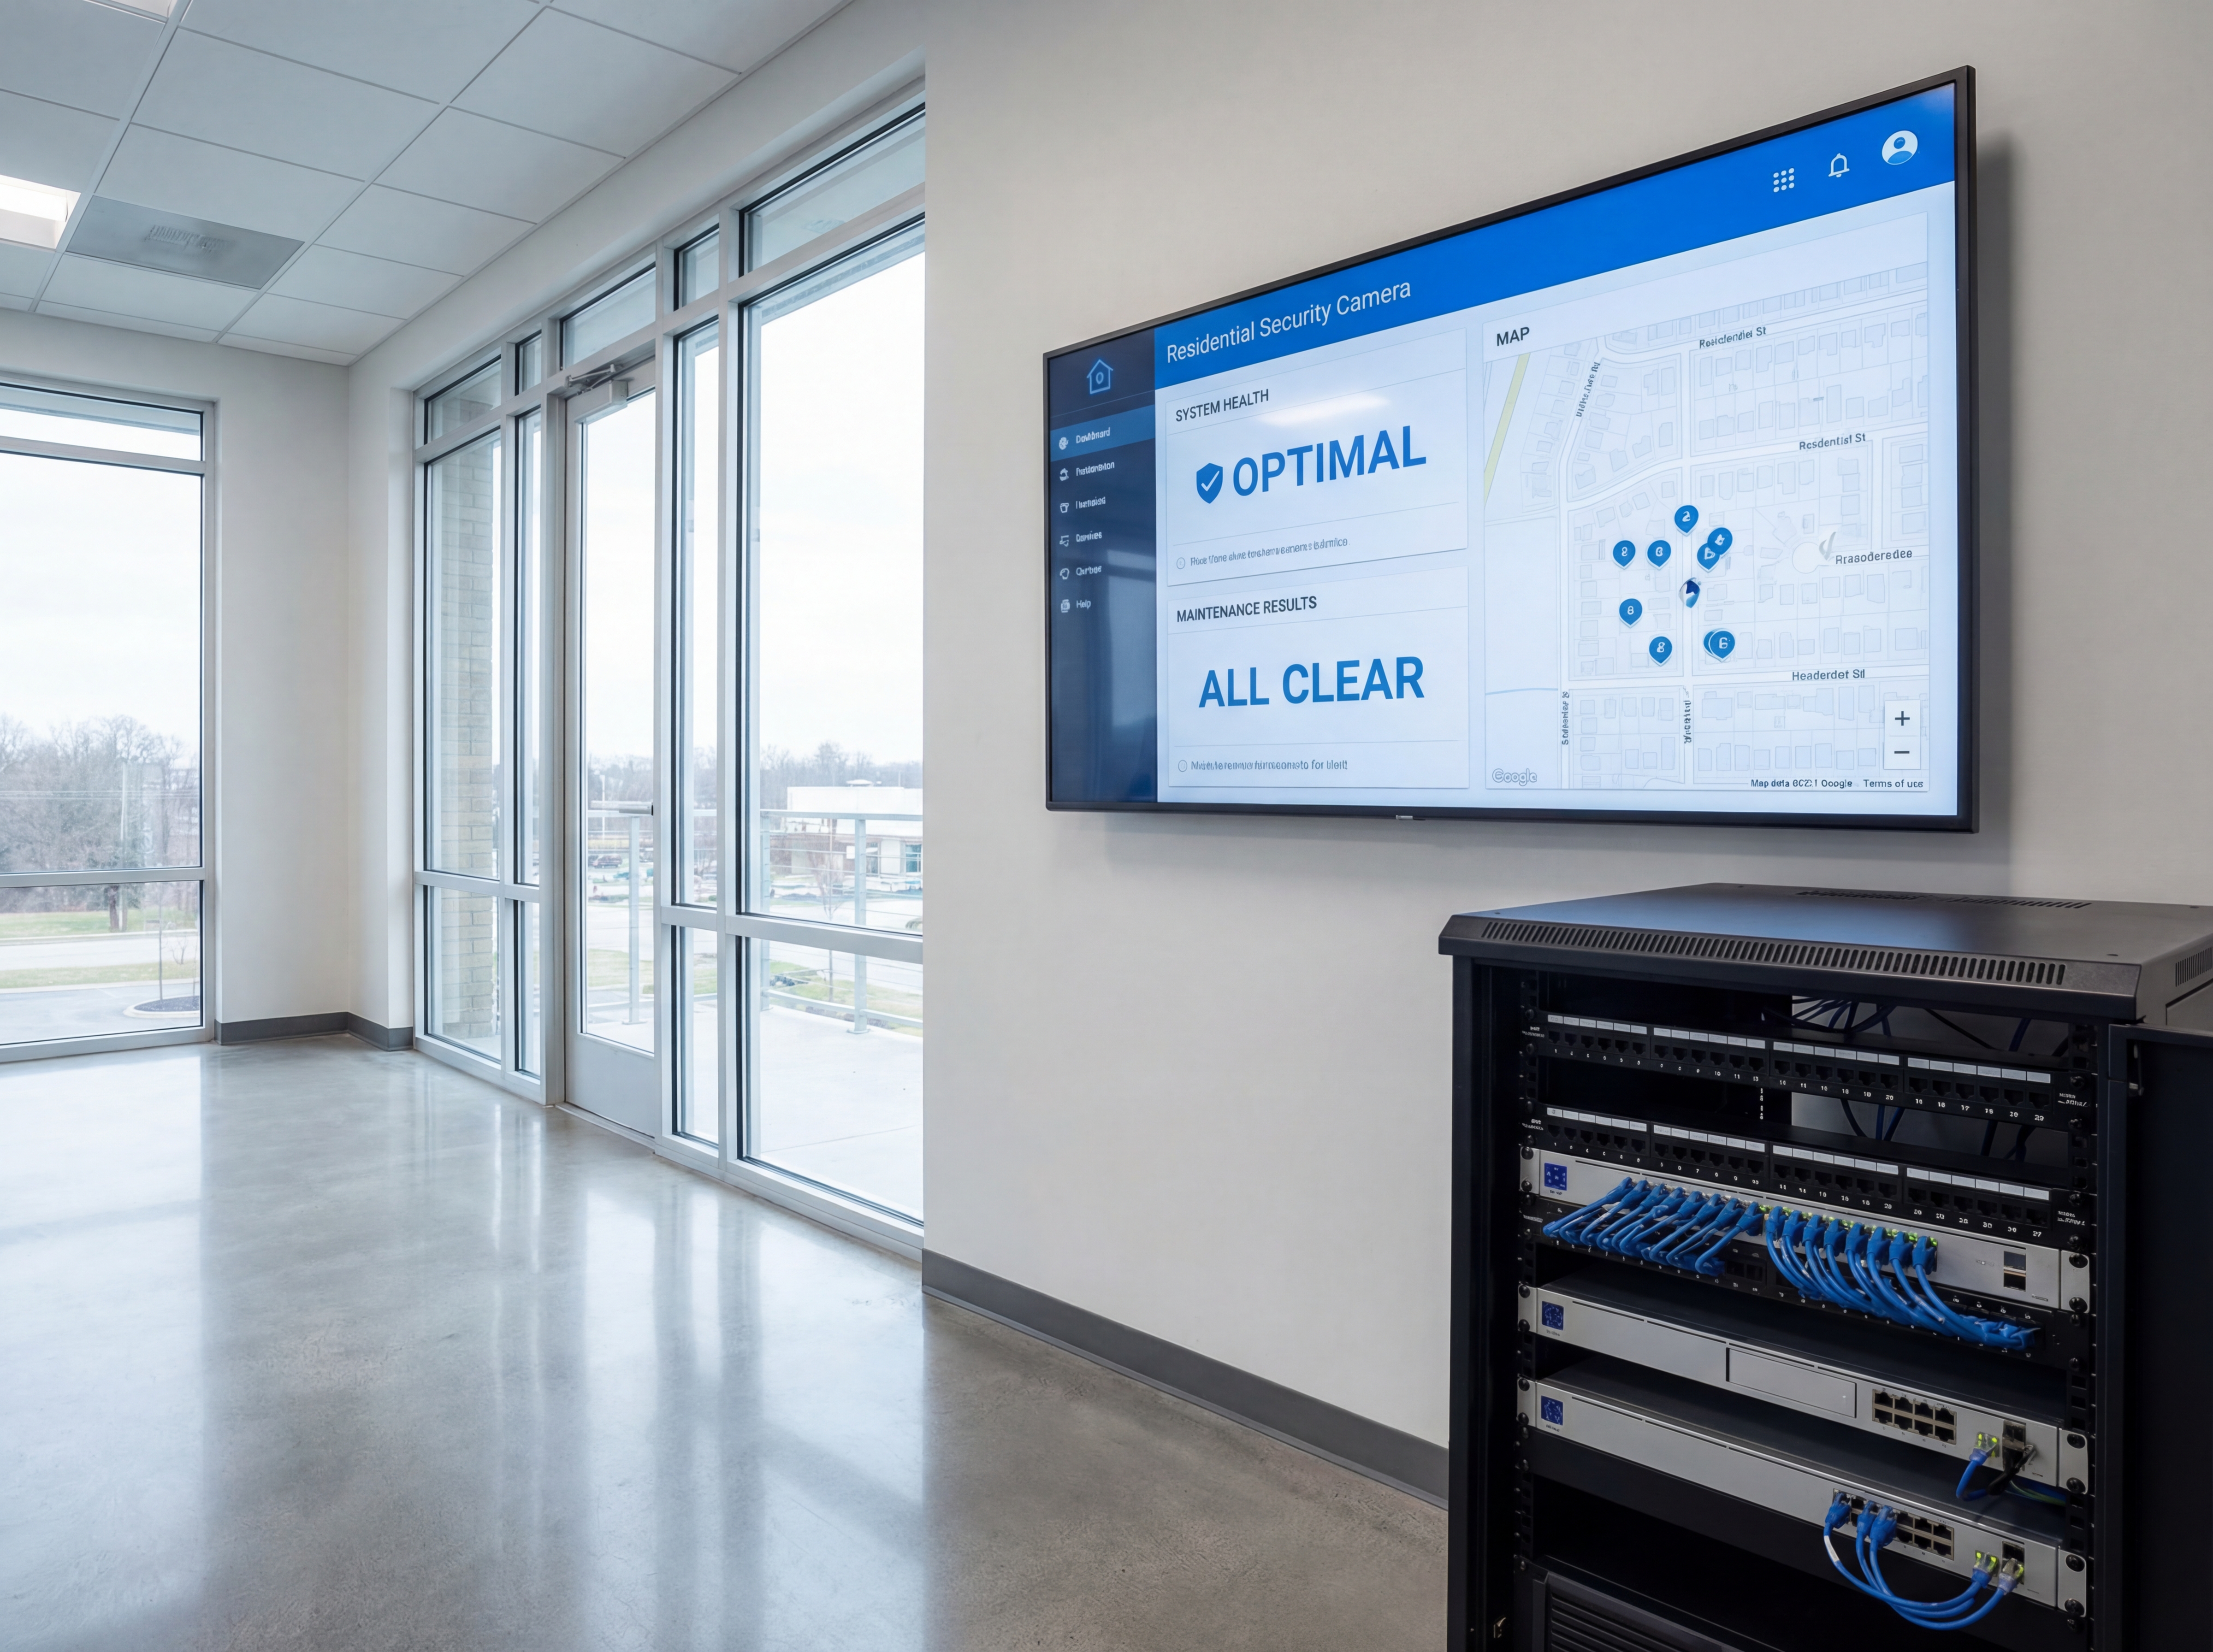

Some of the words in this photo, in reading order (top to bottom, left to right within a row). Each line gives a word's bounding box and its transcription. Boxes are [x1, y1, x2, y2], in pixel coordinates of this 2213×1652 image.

[1167, 321, 1255, 363] Residential
[1260, 304, 1331, 336] Security
[1337, 282, 1411, 315] Camera
[1756, 326, 1766, 336] St
[1497, 326, 1530, 346] MAP
[1176, 400, 1220, 422] SYSTEM
[1224, 389, 1269, 411] HEALTH
[1855, 433, 1866, 442] St
[1233, 425, 1426, 496] OPTIMAL
[1177, 601, 1260, 622] MAINTENANCE
[1263, 596, 1317, 614] RESULTS
[1198, 667, 1270, 708] ALL
[1283, 656, 1425, 704] CLEAR
[1863, 779, 1892, 788] Terms
[1894, 779, 1905, 788] of
